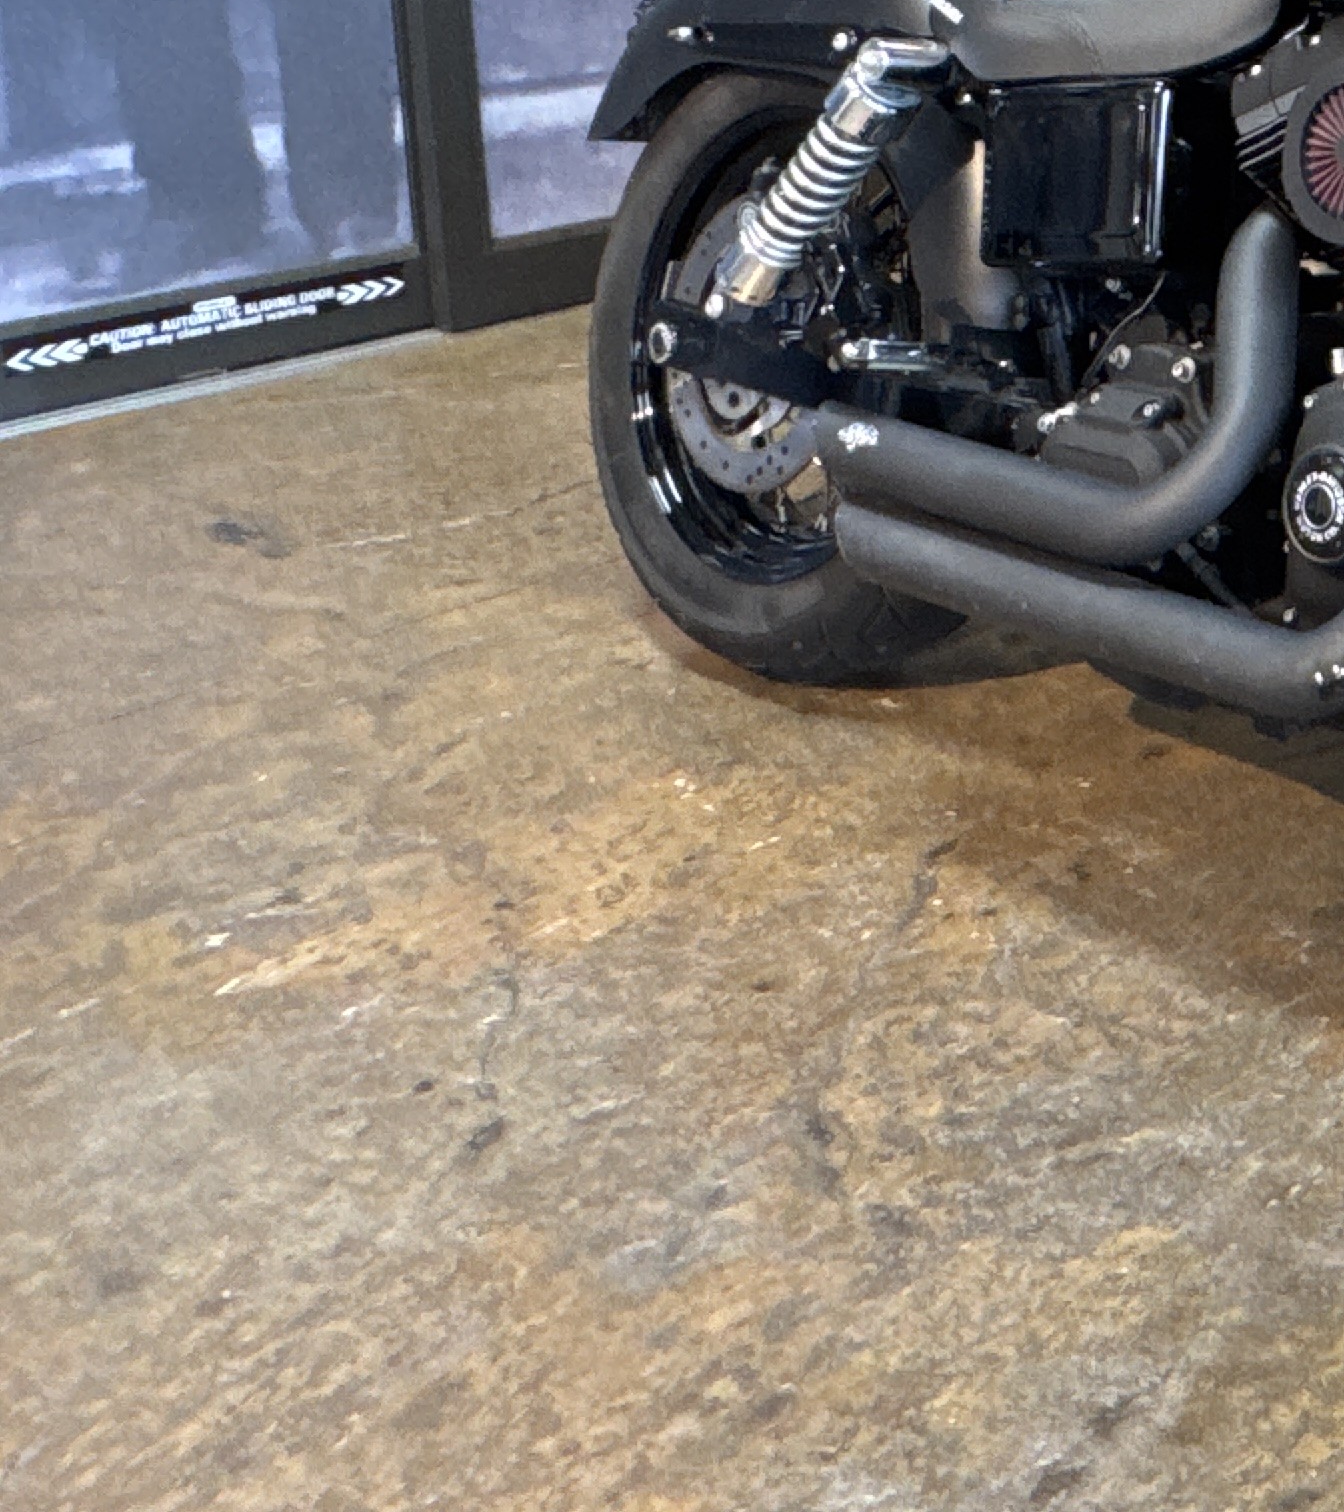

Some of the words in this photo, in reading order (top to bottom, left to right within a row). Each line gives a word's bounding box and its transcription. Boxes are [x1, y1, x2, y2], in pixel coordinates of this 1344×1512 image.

[161, 304, 241, 332] AUTOMATIC
[244, 292, 297, 315] SLIDING
[300, 286, 335, 304] DOOR
